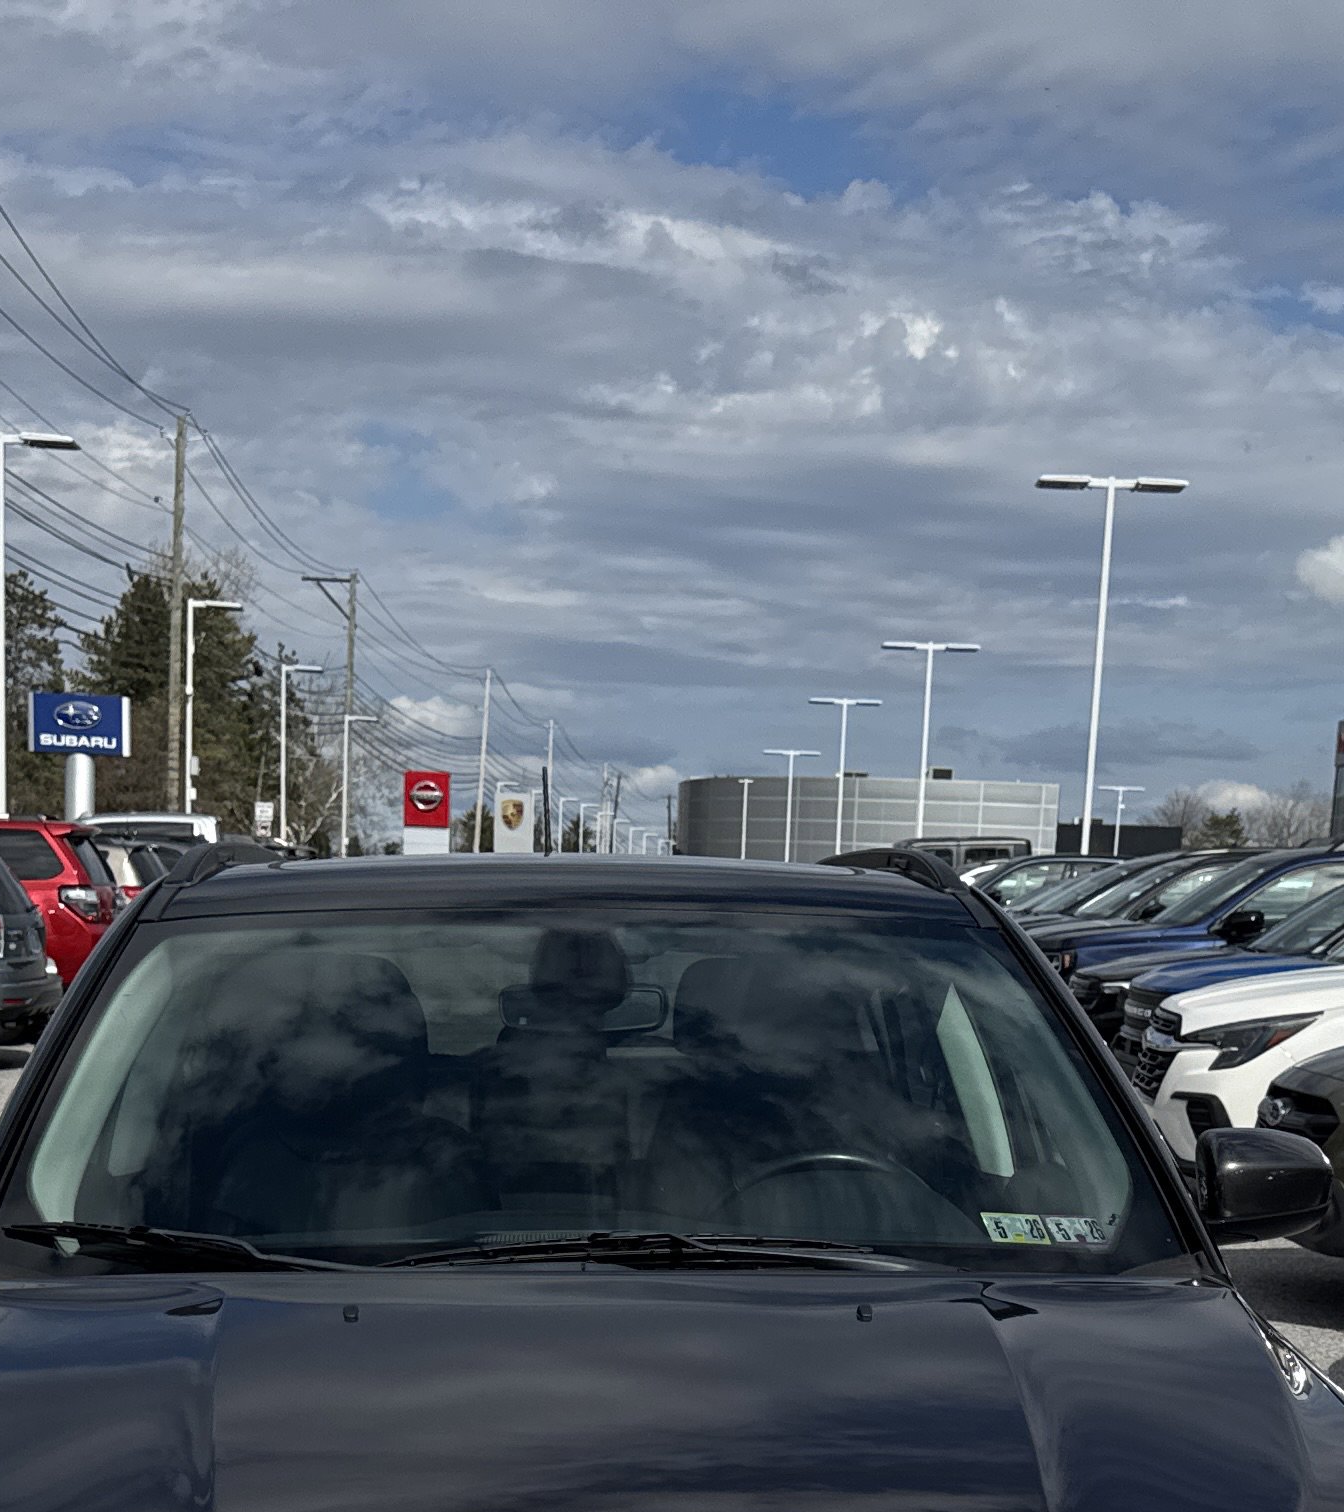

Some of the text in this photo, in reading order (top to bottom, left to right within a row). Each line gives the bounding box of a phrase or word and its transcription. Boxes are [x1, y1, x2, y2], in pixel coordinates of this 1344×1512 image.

[39, 733, 117, 749] SUBARU
[1025, 1218, 1046, 1239] 26
[1084, 1219, 1106, 1241] 26
